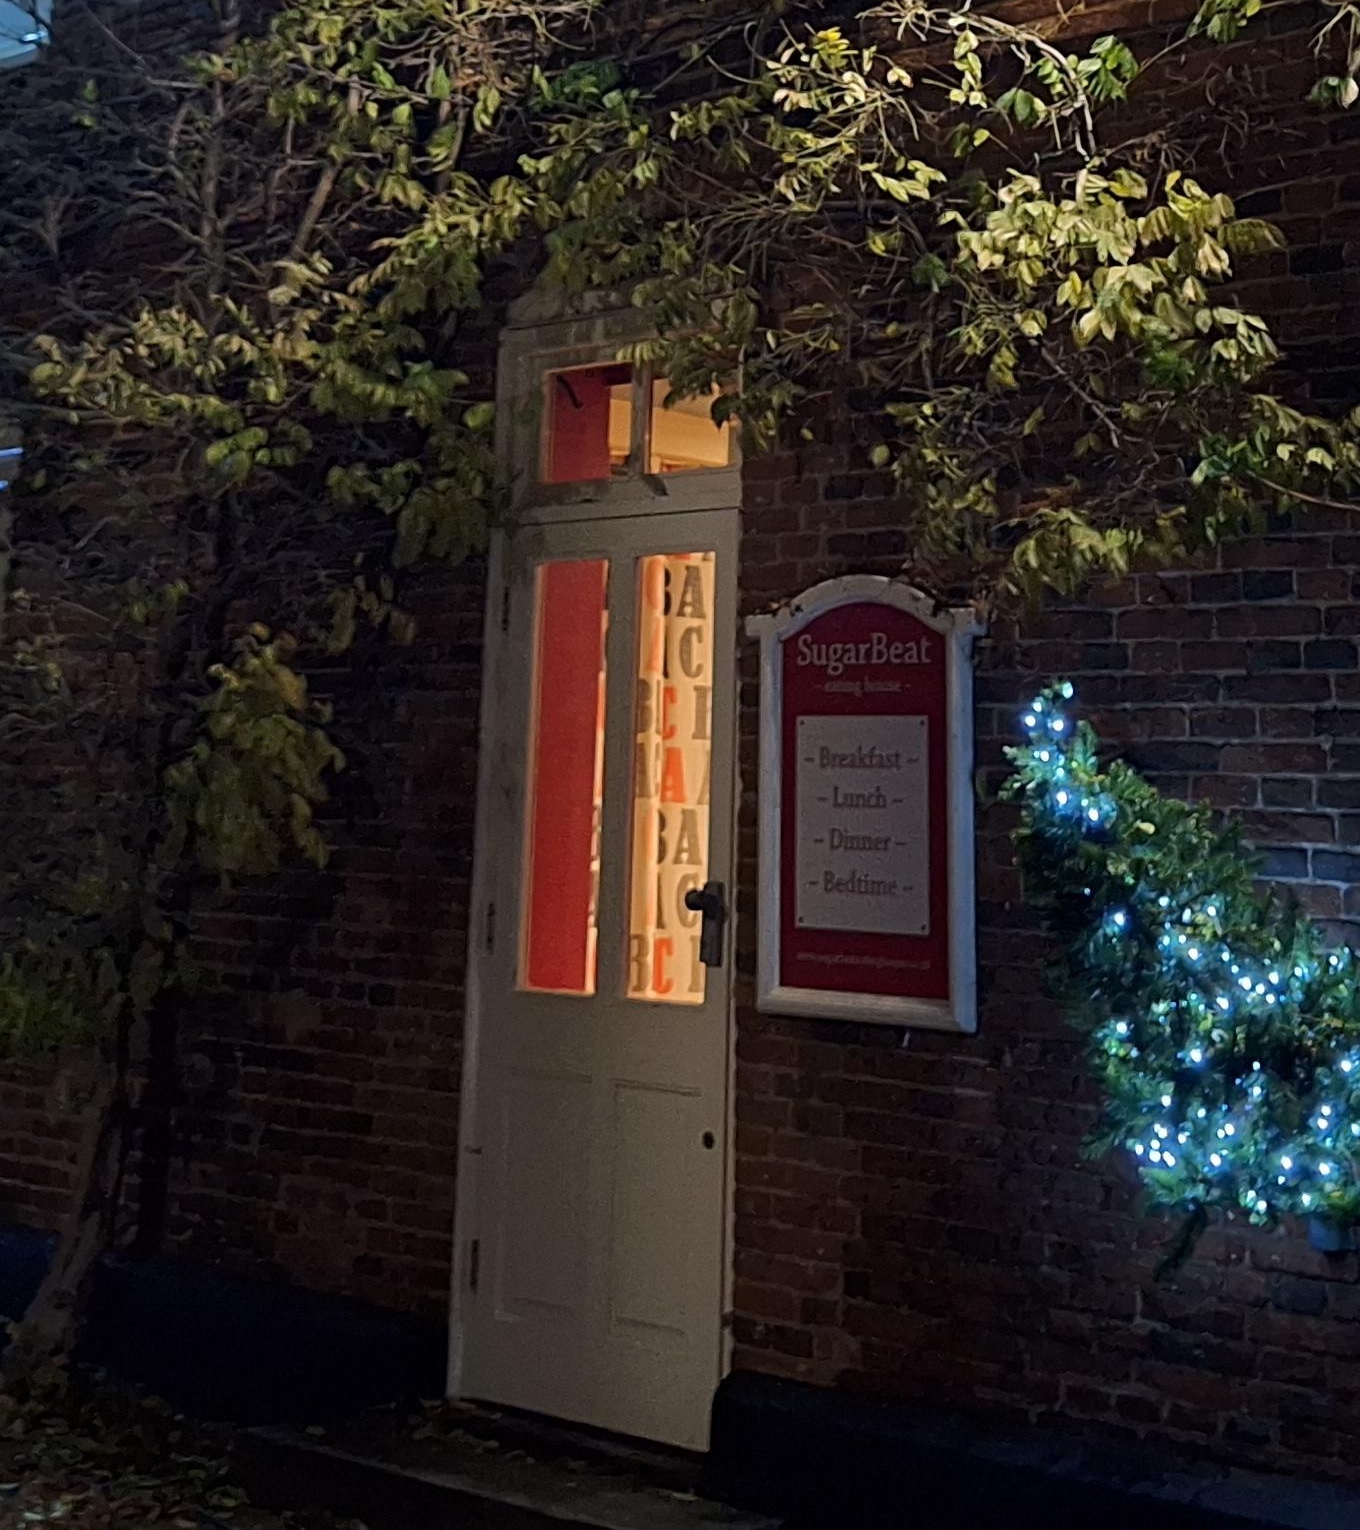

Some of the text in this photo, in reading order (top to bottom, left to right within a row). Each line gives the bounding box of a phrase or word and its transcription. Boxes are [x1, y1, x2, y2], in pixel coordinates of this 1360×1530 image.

[797, 632, 934, 676] SugarBeat
[819, 746, 900, 769] Breakfast
[833, 786, 886, 808] Lunch
[829, 827, 891, 851] Dinner
[823, 869, 898, 895] Bedtime
